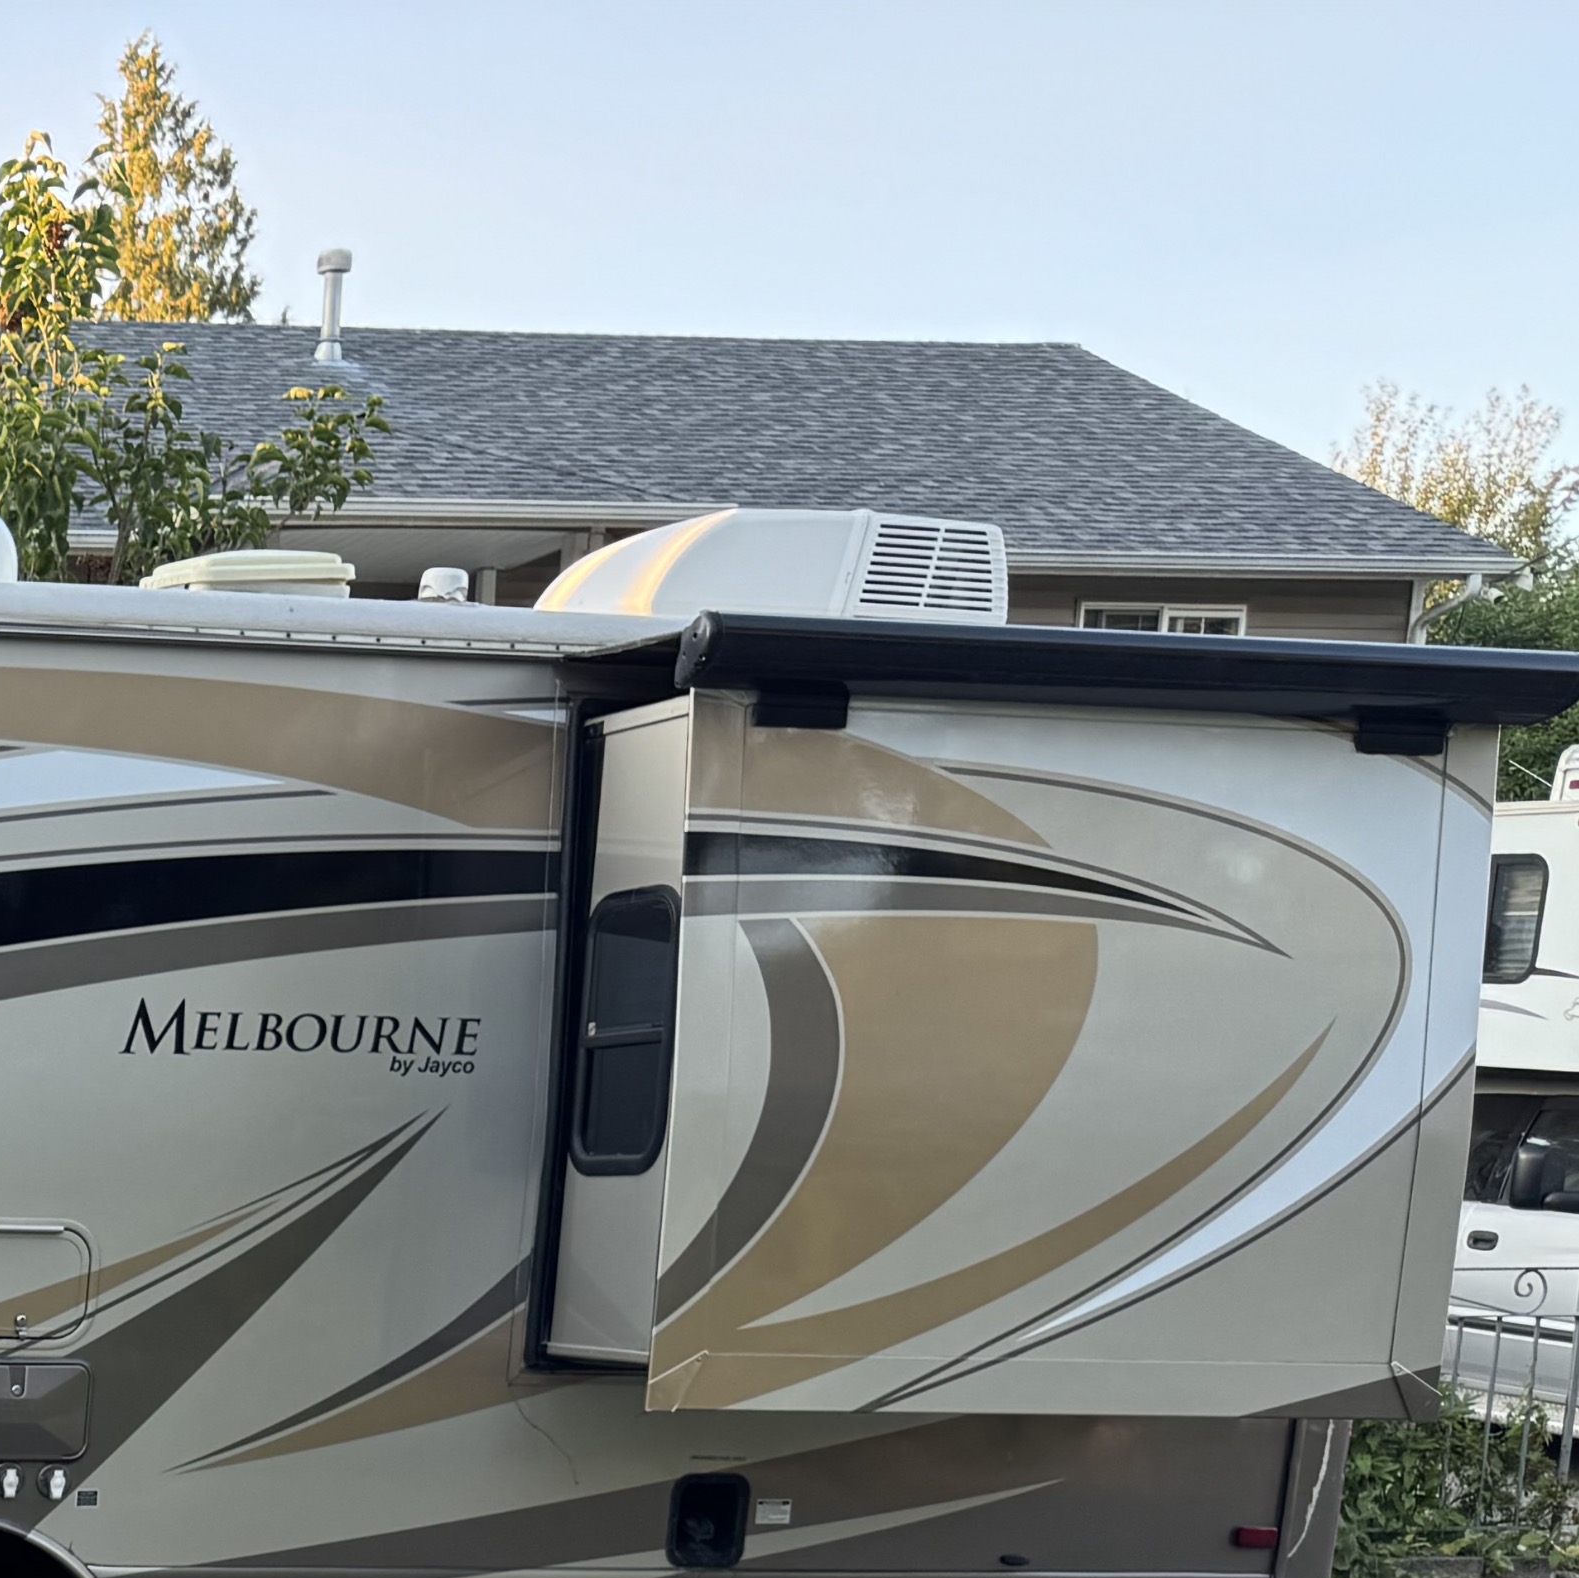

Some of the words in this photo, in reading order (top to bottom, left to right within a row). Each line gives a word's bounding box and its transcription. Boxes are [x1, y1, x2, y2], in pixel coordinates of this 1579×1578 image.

[118, 997, 481, 1056] MELBOURNE
[389, 1056, 414, 1077] by
[417, 1056, 475, 1078] Jayco
